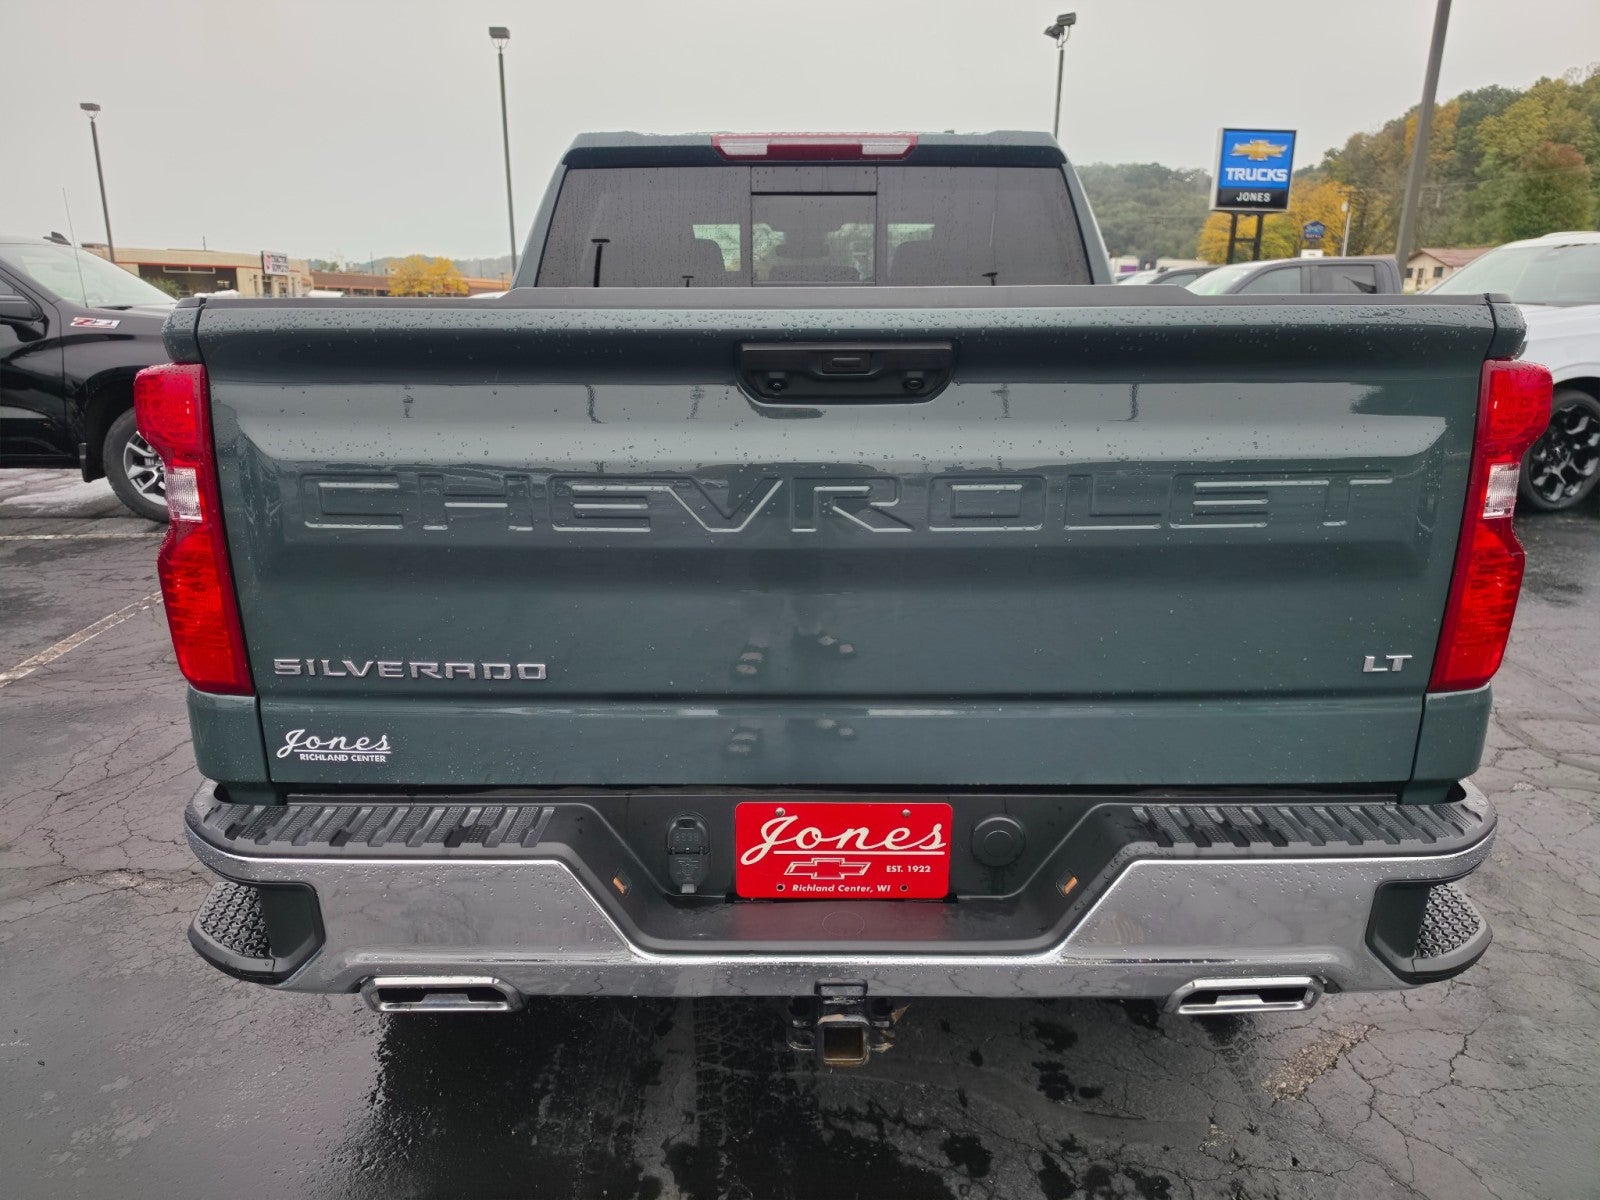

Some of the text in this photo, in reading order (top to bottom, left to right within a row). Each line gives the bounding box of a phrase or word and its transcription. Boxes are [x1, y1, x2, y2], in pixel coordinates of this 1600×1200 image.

[1225, 167, 1288, 182] TRUCKS
[1236, 191, 1271, 202] JONES
[300, 470, 1394, 533] CHEVROLET
[273, 658, 548, 680] SILVERADO
[1363, 654, 1413, 673] LT
[276, 728, 391, 759] Jones
[299, 753, 387, 763] RICHLAND CENTER
[740, 815, 947, 866] Jones
[886, 865, 931, 873] EST. 1922
[792, 884, 891, 893] Richland Center, WI
